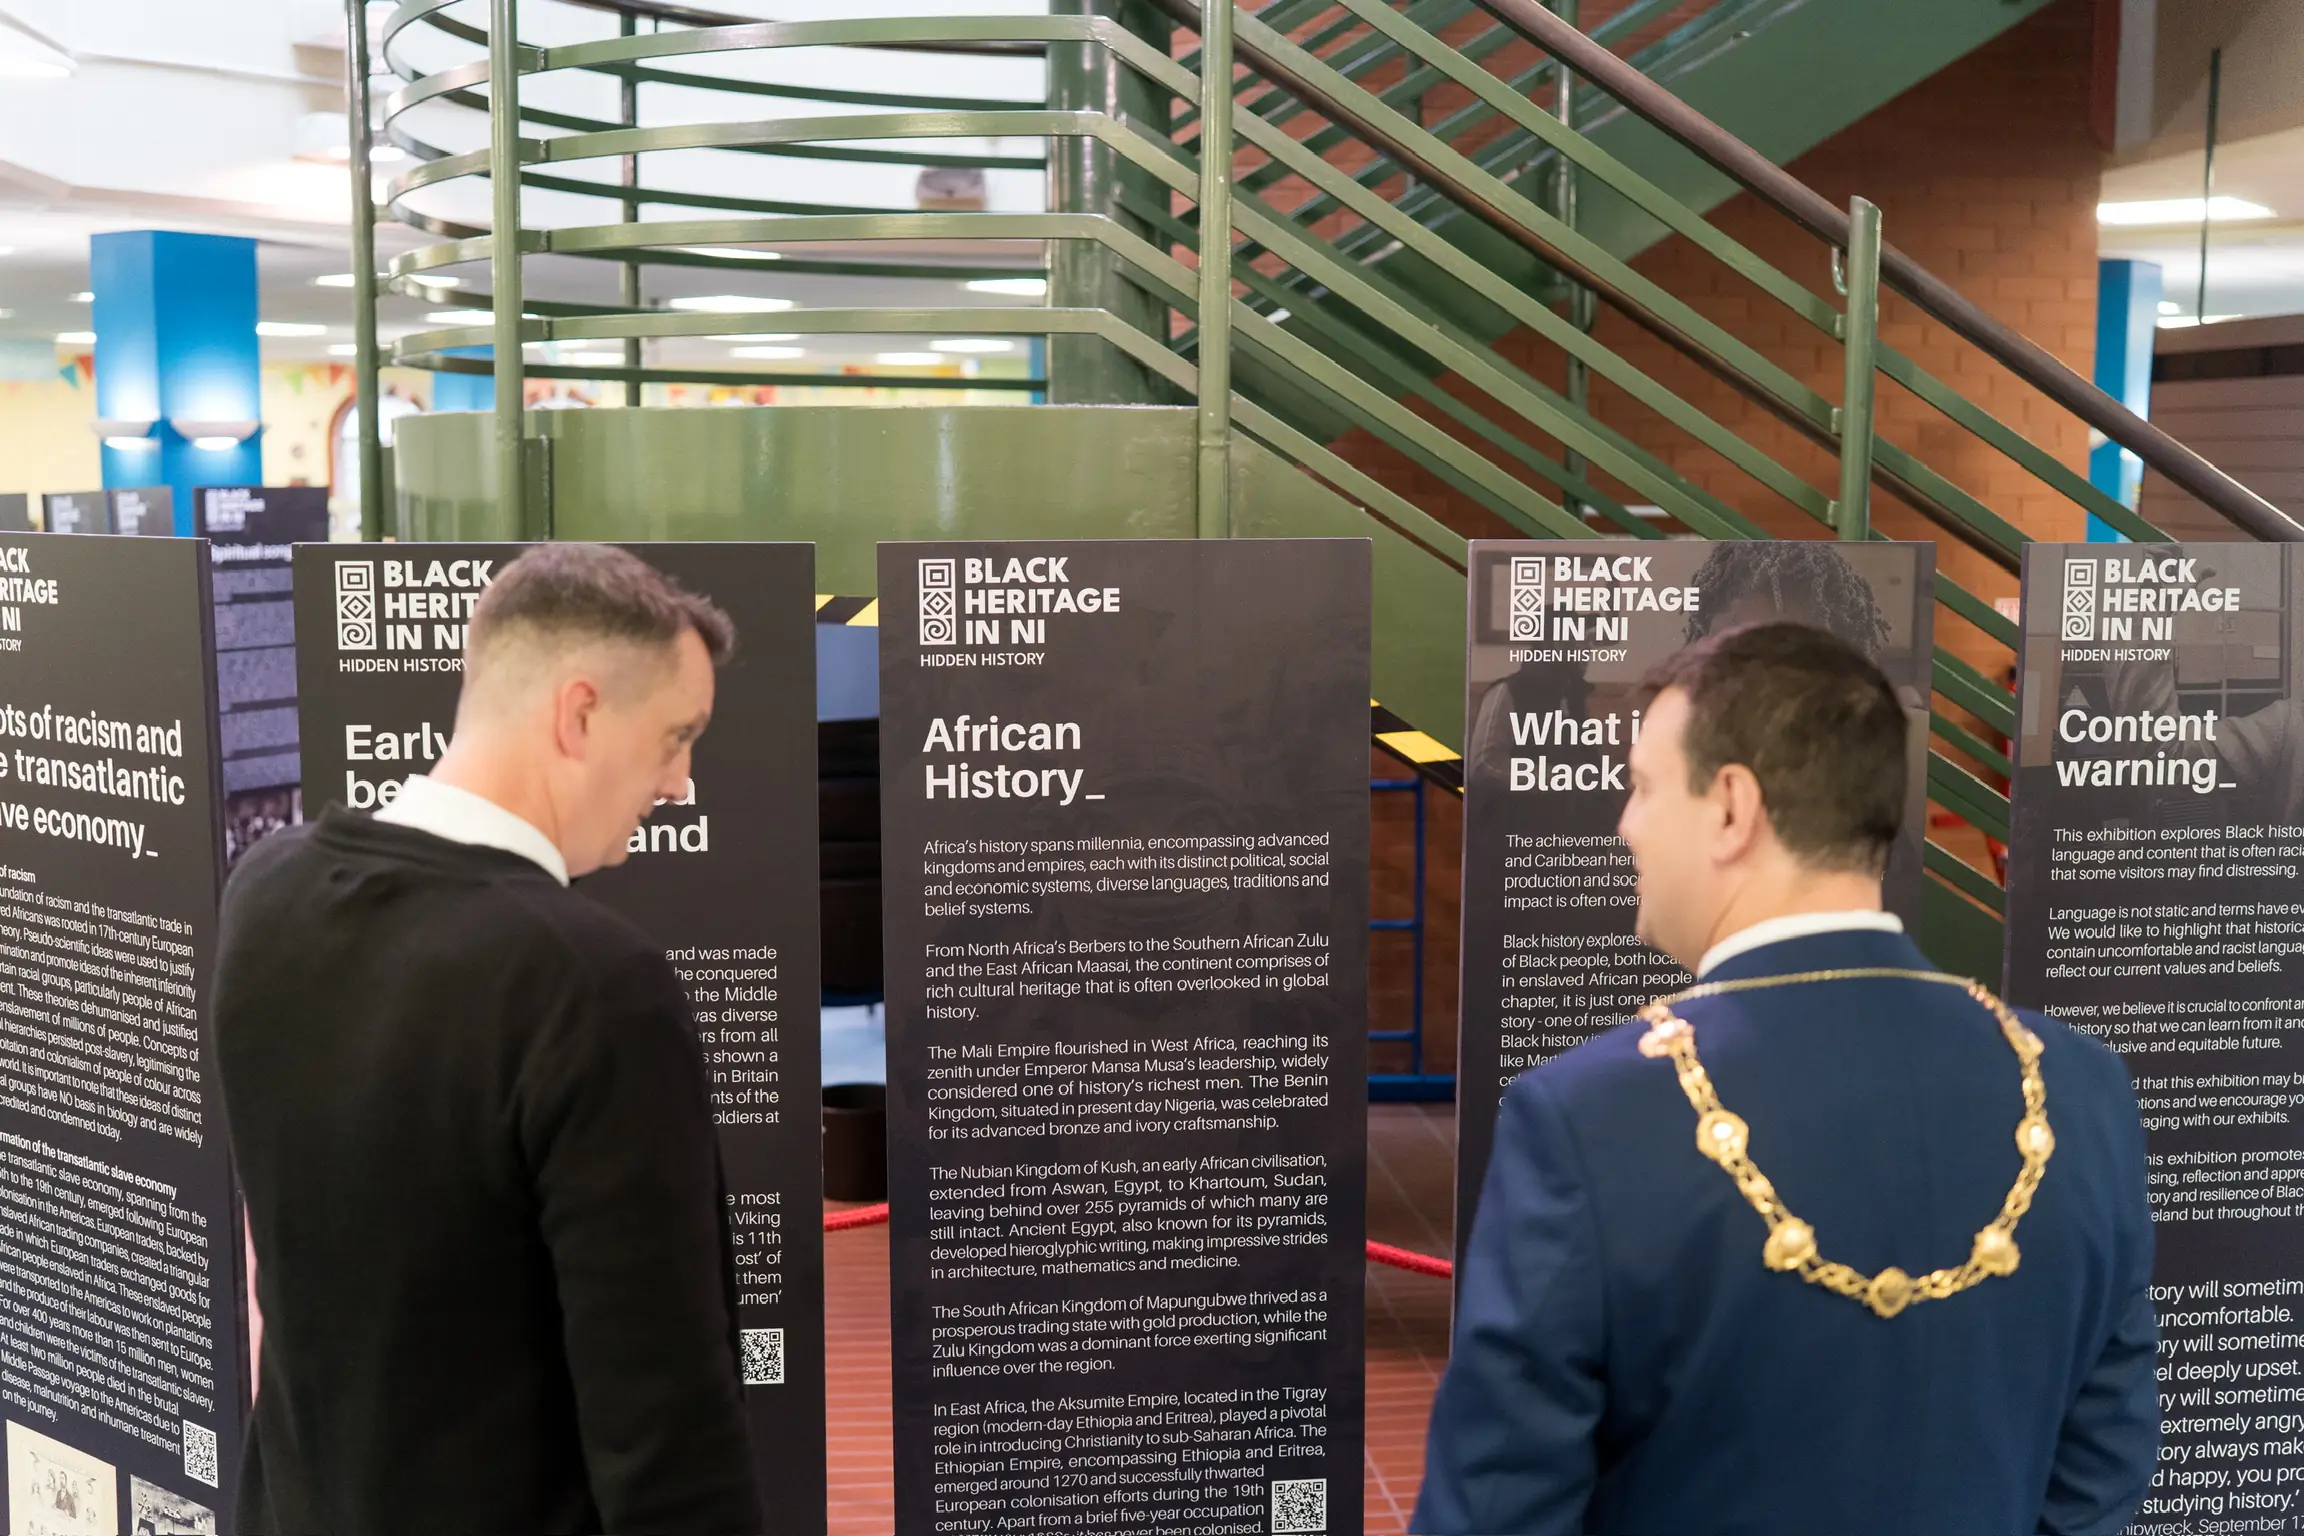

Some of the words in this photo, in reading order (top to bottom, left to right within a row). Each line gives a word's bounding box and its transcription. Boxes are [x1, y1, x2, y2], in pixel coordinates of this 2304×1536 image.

[383, 560, 493, 588] BLACK
[965, 557, 1069, 584] BLACK
[1554, 556, 1653, 582] BLACK
[2105, 558, 2197, 583] BLACK
[384, 592, 480, 618] HERIT
[965, 588, 1120, 614] HERITAGE
[1553, 587, 1699, 611] HERITAGE
[2103, 588, 2240, 612] HERITAGE
[2, 606, 21, 631] NI
[1553, 617, 1585, 641] IN
[1596, 617, 1628, 641] NI
[2102, 617, 2132, 640] IN
[2142, 617, 2172, 640] NI
[386, 624, 422, 650] IN
[966, 620, 999, 644] IN
[1011, 619, 1045, 644] NI
[339, 658, 399, 672] HIDDEN
[921, 654, 976, 667] HIDDEN
[982, 652, 1045, 666] HISTORY
[1510, 650, 1562, 662] HIDDEN
[1567, 649, 1627, 662] HISTORY
[2061, 649, 2110, 661] HIDDEN
[2115, 649, 2171, 661] HISTORY
[30, 704, 52, 740] of
[55, 710, 132, 751] racism
[136, 719, 182, 757] and
[922, 715, 1080, 752] African
[1509, 710, 1621, 745] What
[2060, 709, 2218, 743] Content
[14, 749, 185, 805] transatlantic
[1510, 755, 1625, 791] Black
[980, 839, 1028, 855] history
[1031, 840, 1074, 854] spans
[1077, 837, 1144, 851] millennia,
[1148, 835, 1254, 851] encompassing
[1258, 831, 1329, 847] advanced
[1506, 834, 1533, 847] The
[8, 868, 36, 883] racism
[924, 860, 995, 878] kingdoms
[998, 859, 1024, 873] and
[1028, 859, 1086, 874] empires,
[1090, 856, 1124, 871] each
[1127, 856, 1157, 869] with
[1160, 856, 1175, 869] its
[1177, 855, 1227, 868] distinct
[1231, 853, 1286, 870] political,
[1289, 852, 1329, 866] social
[2051, 867, 2076, 880] that
[2079, 869, 2116, 880] some
[2119, 866, 2164, 879] visitors
[2168, 867, 2196, 881] may
[2199, 864, 2223, 877] find
[2226, 863, 2298, 879] distressing.
[924, 881, 952, 896] and
[955, 880, 1029, 895] economic
[1032, 879, 1093, 896] systems,
[1096, 877, 1149, 892] diverse
[1152, 876, 1230, 893] languages,
[1233, 873, 1299, 888] traditions
[1302, 872, 1329, 887] and
[35, 892, 44, 905] of
[45, 896, 72, 911] racism
[74, 901, 90, 914] and
[91, 902, 105, 918] the
[107, 907, 158, 928] transatlantic
[159, 917, 182, 934] trade
[184, 921, 192, 935] in
[925, 901, 966, 916] belief
[969, 902, 1033, 918] systems.
[1504, 895, 1553, 911] impact
[1556, 895, 1567, 907] is
[1570, 893, 1606, 907] often
[666, 946, 695, 960] and
[698, 949, 730, 960] was
[733, 945, 777, 960] made
[1504, 934, 1539, 948] Black
[1542, 934, 1585, 950] history
[1586, 932, 1640, 950] explores
[696, 966, 777, 983] conquered
[1502, 975, 1515, 987] in
[1519, 973, 1584, 987] enslaved
[1588, 972, 1638, 985] African
[1643, 971, 1692, 987] people
[2046, 964, 2086, 978] reflect
[2089, 966, 2112, 977] our
[2114, 963, 2161, 976] current
[2164, 961, 2206, 975] values
[2209, 960, 2234, 974] and
[2237, 959, 2282, 973] beliefs.
[694, 987, 719, 1002] the
[725, 986, 777, 1001] Middle
[927, 1046, 956, 1059] The
[962, 1044, 992, 1058] Mali
[998, 1044, 1050, 1059] Empire
[1055, 1039, 1128, 1055] flourished
[1134, 1040, 1146, 1052] in
[1151, 1039, 1188, 1052] West
[1193, 1036, 1237, 1051] Africa,
[1243, 1035, 1307, 1051] reaching
[1313, 1034, 1328, 1047] its
[714, 1070, 727, 1083] in
[732, 1069, 778, 1082] Britain
[32, 1140, 41, 1154] of
[41, 1142, 56, 1158] the
[57, 1148, 110, 1176] transatlantic
[111, 1165, 134, 1183] slave
[135, 1175, 177, 1200] economy
[929, 1184, 1004, 1200] extended
[1010, 1183, 1046, 1196] from
[1052, 1182, 1107, 1195] Aswan,
[1115, 1180, 1162, 1196] Egypt,
[1168, 1179, 1184, 1191] to
[1189, 1176, 1268, 1190] Khartoum,
[1274, 1173, 1327, 1187] Sudan,
[732, 1232, 744, 1245] is
[748, 1230, 781, 1244] 11th
[735, 1251, 762, 1265] ost'
[766, 1250, 781, 1264] of
[934, 1478, 997, 1495] emerged
[1000, 1475, 1049, 1490] around
[1053, 1473, 1088, 1487] 1270
[1090, 1472, 1117, 1486] and
[1119, 1467, 1202, 1484] successfully
[1204, 1464, 1264, 1480] thwarted
[2143, 1494, 2223, 1516] studying
